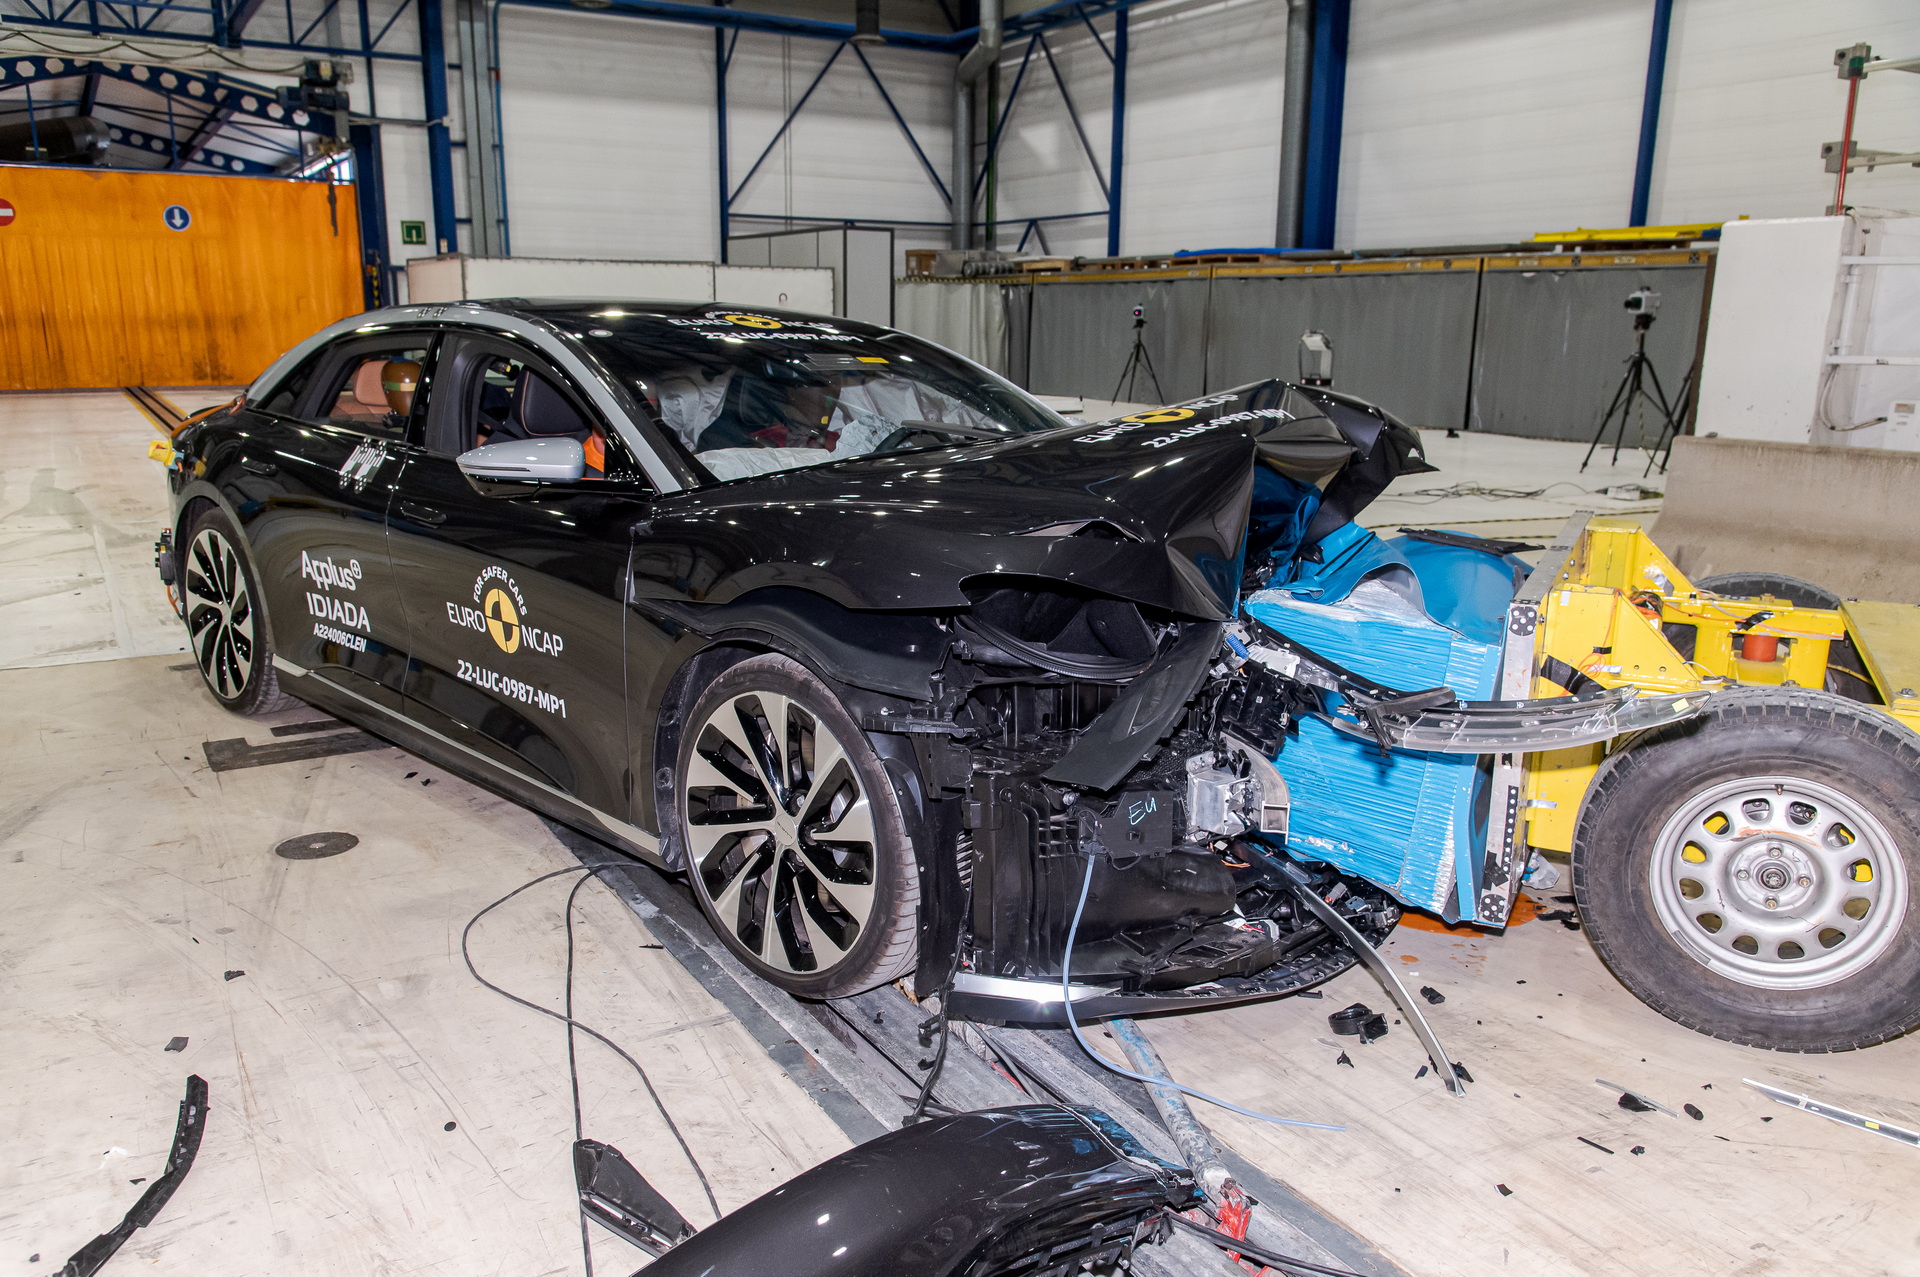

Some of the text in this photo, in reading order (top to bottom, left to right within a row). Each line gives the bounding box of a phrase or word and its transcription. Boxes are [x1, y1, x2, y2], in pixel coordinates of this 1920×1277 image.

[668, 318, 734, 326] EURO
[1073, 394, 1239, 444] EURO NCAP
[1141, 408, 1296, 449] 22-LUC-0987-MP1
[306, 591, 371, 633] IDIADA
[473, 565, 528, 616] FOR SAFER CARS
[313, 622, 367, 653] A224006CLEN
[446, 601, 564, 657] EURO NCAP
[456, 659, 567, 719] 22-LUC-0987-MP1
